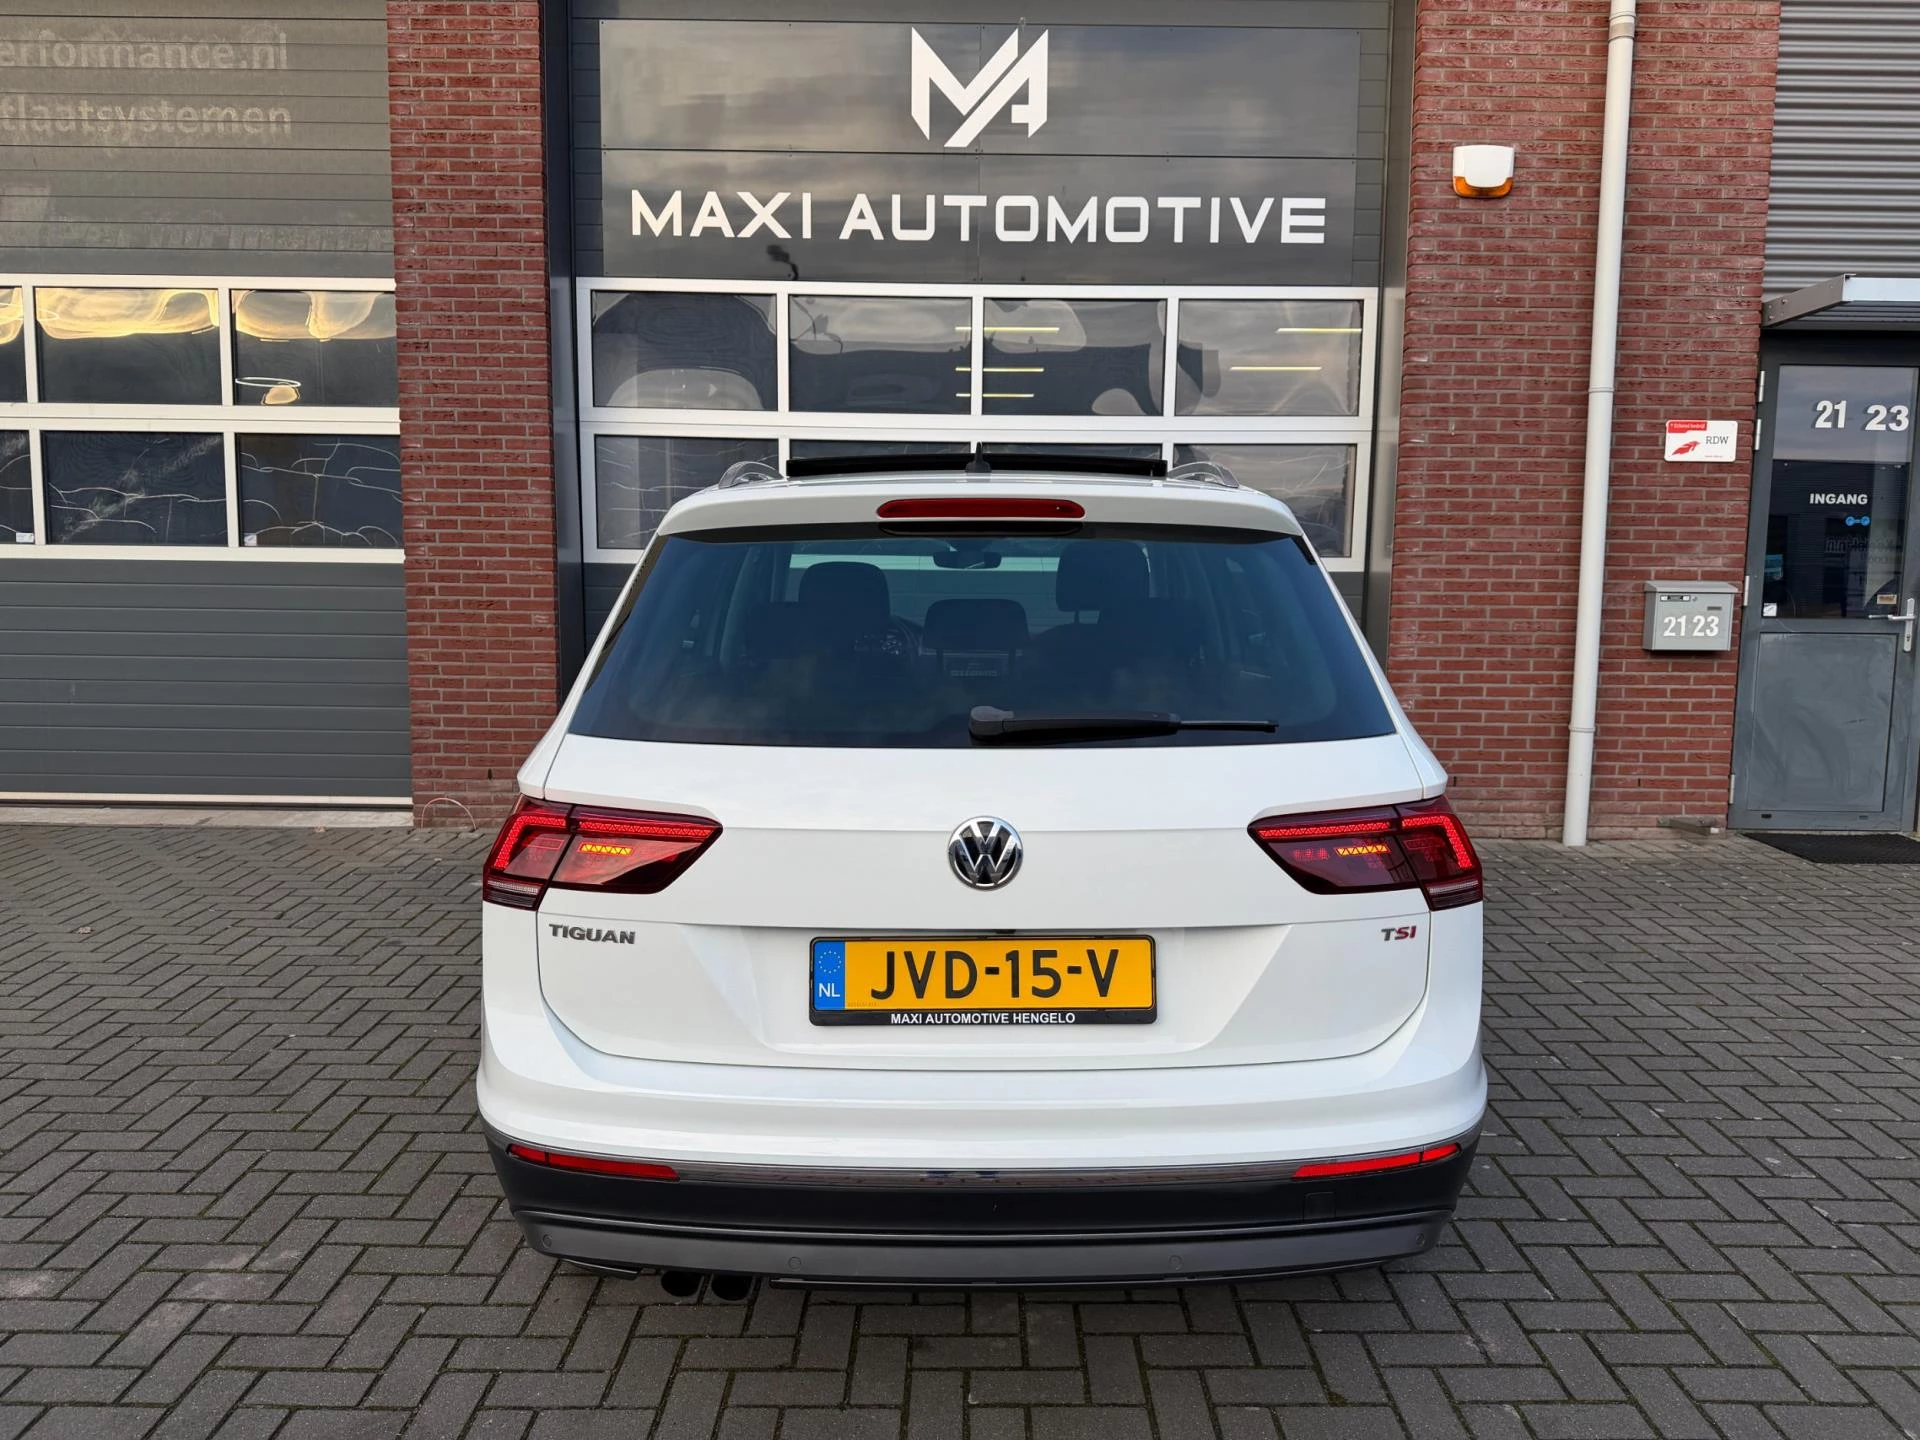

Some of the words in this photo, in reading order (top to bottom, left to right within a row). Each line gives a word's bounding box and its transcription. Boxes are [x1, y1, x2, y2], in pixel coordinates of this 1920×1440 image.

[631, 188, 812, 240] MAXI
[838, 192, 1327, 245] AUTOMOTIVE
[1814, 400, 1847, 429] 21
[1864, 404, 1909, 432] 23
[1705, 436, 1729, 444] RDW
[1809, 493, 1868, 505] INGANG
[1663, 615, 1687, 637] 21
[1692, 615, 1719, 637] 23
[549, 924, 636, 944] TIGUAN
[1381, 925, 1417, 942] TSI
[870, 949, 1120, 1000] JVD-15-V
[818, 983, 841, 998] NL
[890, 1013, 922, 1024] MAXI
[925, 1013, 1009, 1024] AUTOMOTIVE
[1012, 1012, 1076, 1024] HENGELO
